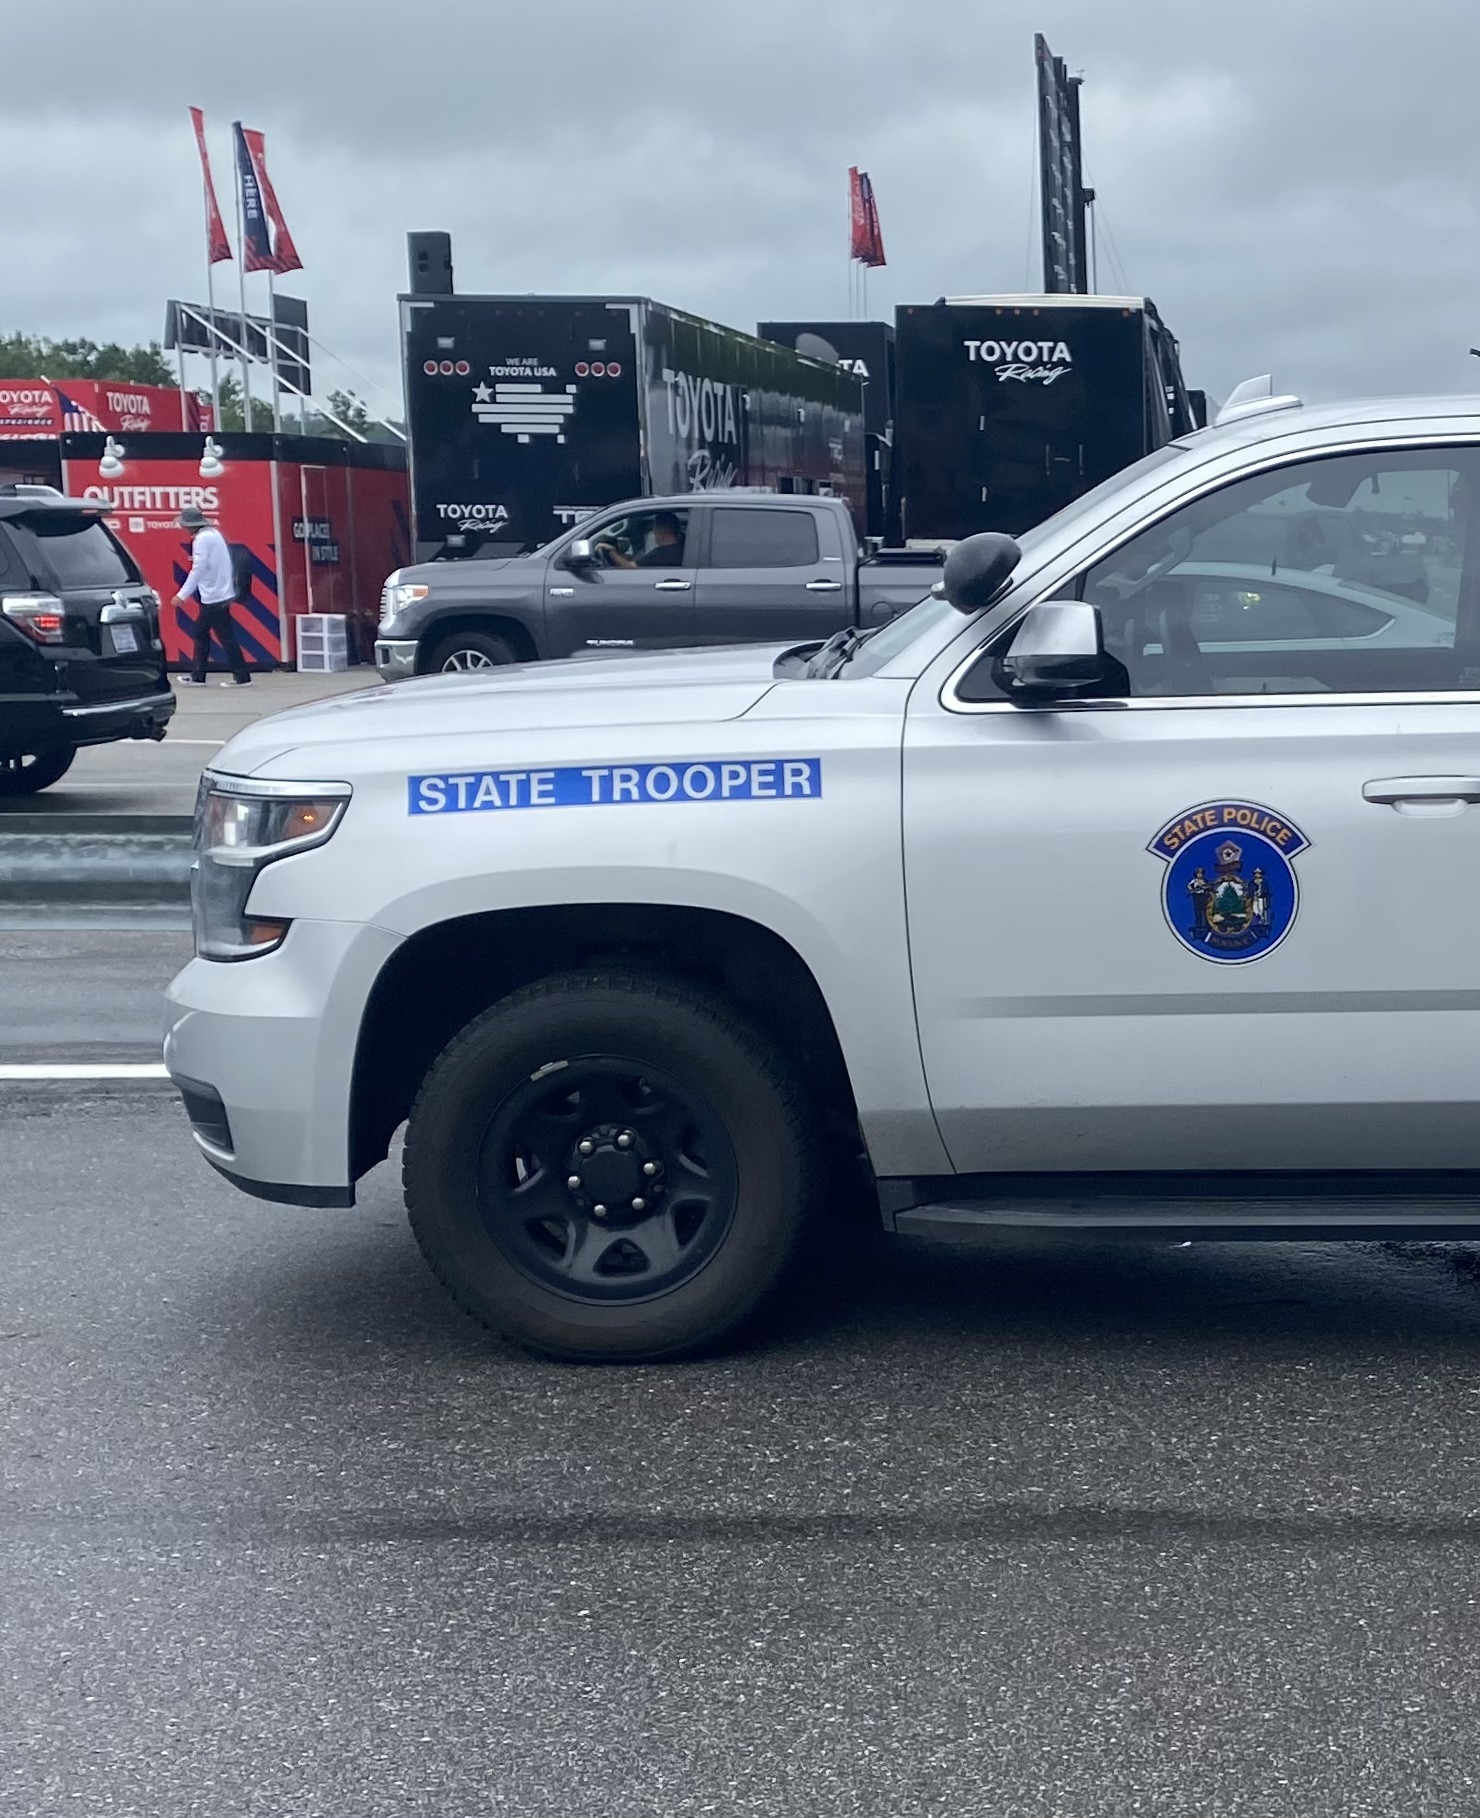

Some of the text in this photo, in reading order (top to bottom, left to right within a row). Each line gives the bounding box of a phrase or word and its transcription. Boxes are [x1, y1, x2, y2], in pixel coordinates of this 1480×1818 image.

[244, 174, 258, 219] HERE
[505, 358, 538, 366] WE ARE
[963, 340, 1072, 362] TOYOTA
[489, 366, 556, 377] TOYOTA USA
[994, 363, 1072, 385] Racing
[106, 391, 151, 413] TOYOTA
[662, 368, 737, 444] TOYOTA
[83, 486, 219, 509] OUTFITTERS
[436, 504, 508, 519] TOYOTA
[146, 520, 182, 529] TOYOTA
[458, 519, 508, 533] Racing
[418, 762, 812, 812] STATE TROOPER
[1163, 807, 1293, 849] STATE POLICE
